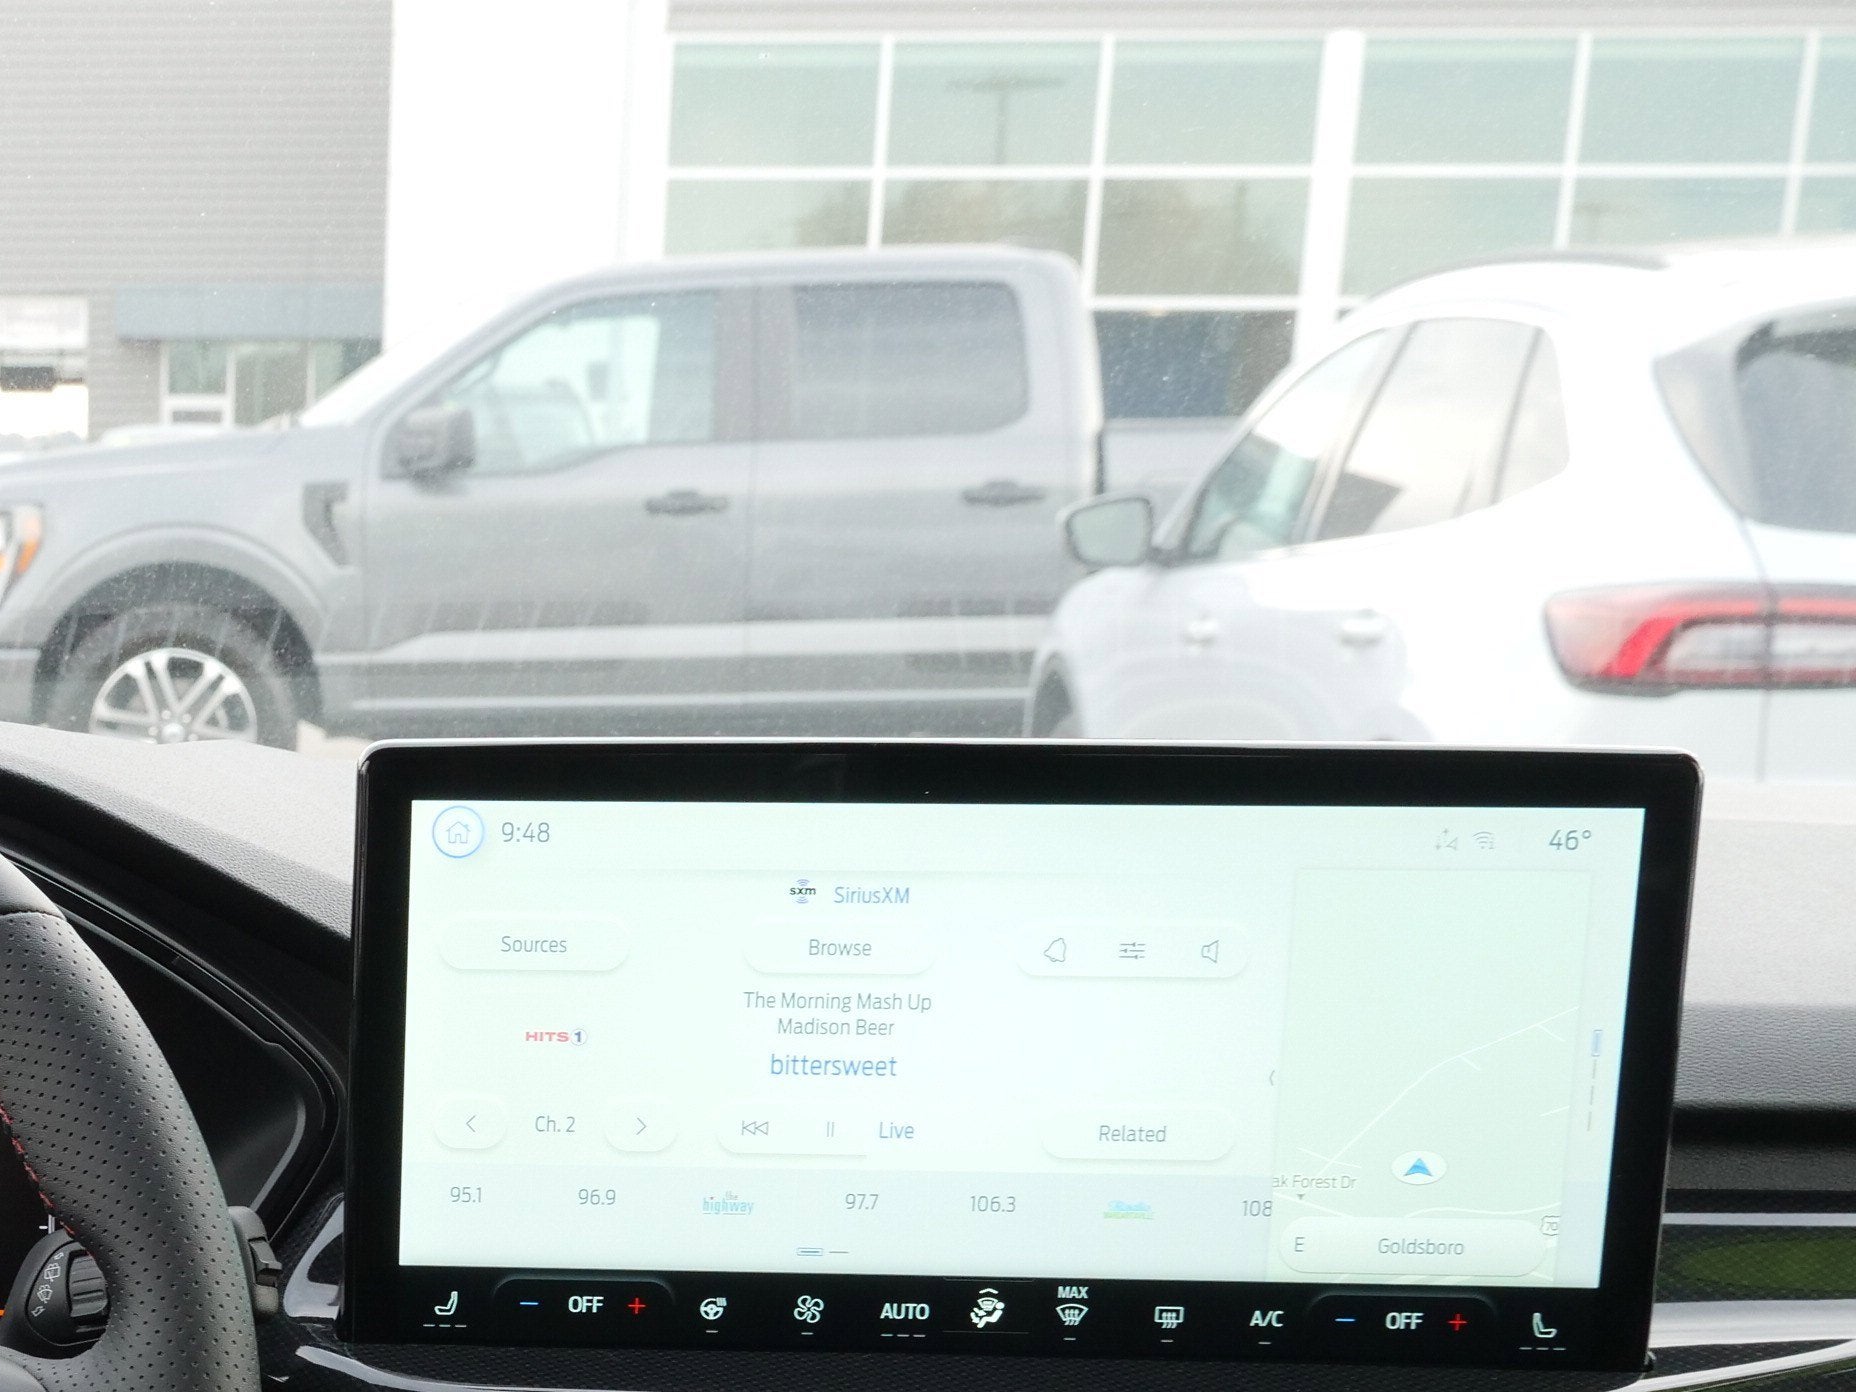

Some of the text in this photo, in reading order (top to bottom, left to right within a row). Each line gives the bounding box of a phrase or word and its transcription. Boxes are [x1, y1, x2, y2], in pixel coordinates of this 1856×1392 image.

[501, 821, 550, 843] 9:48
[833, 886, 910, 904] SiriusXM
[500, 935, 567, 953] Sources
[808, 938, 872, 957] Browse
[742, 990, 932, 1014] The Morning Mash Up
[777, 1017, 895, 1036] Madison Beer
[770, 1053, 898, 1077] bittersweet
[535, 1115, 576, 1133] Ch. 2
[879, 1121, 915, 1139] Live
[1098, 1124, 1167, 1143] Related
[1292, 1175, 1337, 1189] Forest
[1340, 1175, 1357, 1189] Dr
[450, 1186, 482, 1203] 95.1
[578, 1188, 616, 1206] 96.9
[845, 1193, 879, 1210] 97.7
[970, 1195, 1016, 1213] 106.3
[1294, 1236, 1305, 1253] E
[1378, 1237, 1464, 1256] Goldsboro
[1057, 1285, 1089, 1299] MAX
[568, 1295, 605, 1313] OFF
[879, 1302, 930, 1320] AUTO
[1249, 1310, 1285, 1328] A/C
[1385, 1311, 1424, 1330] OFF
